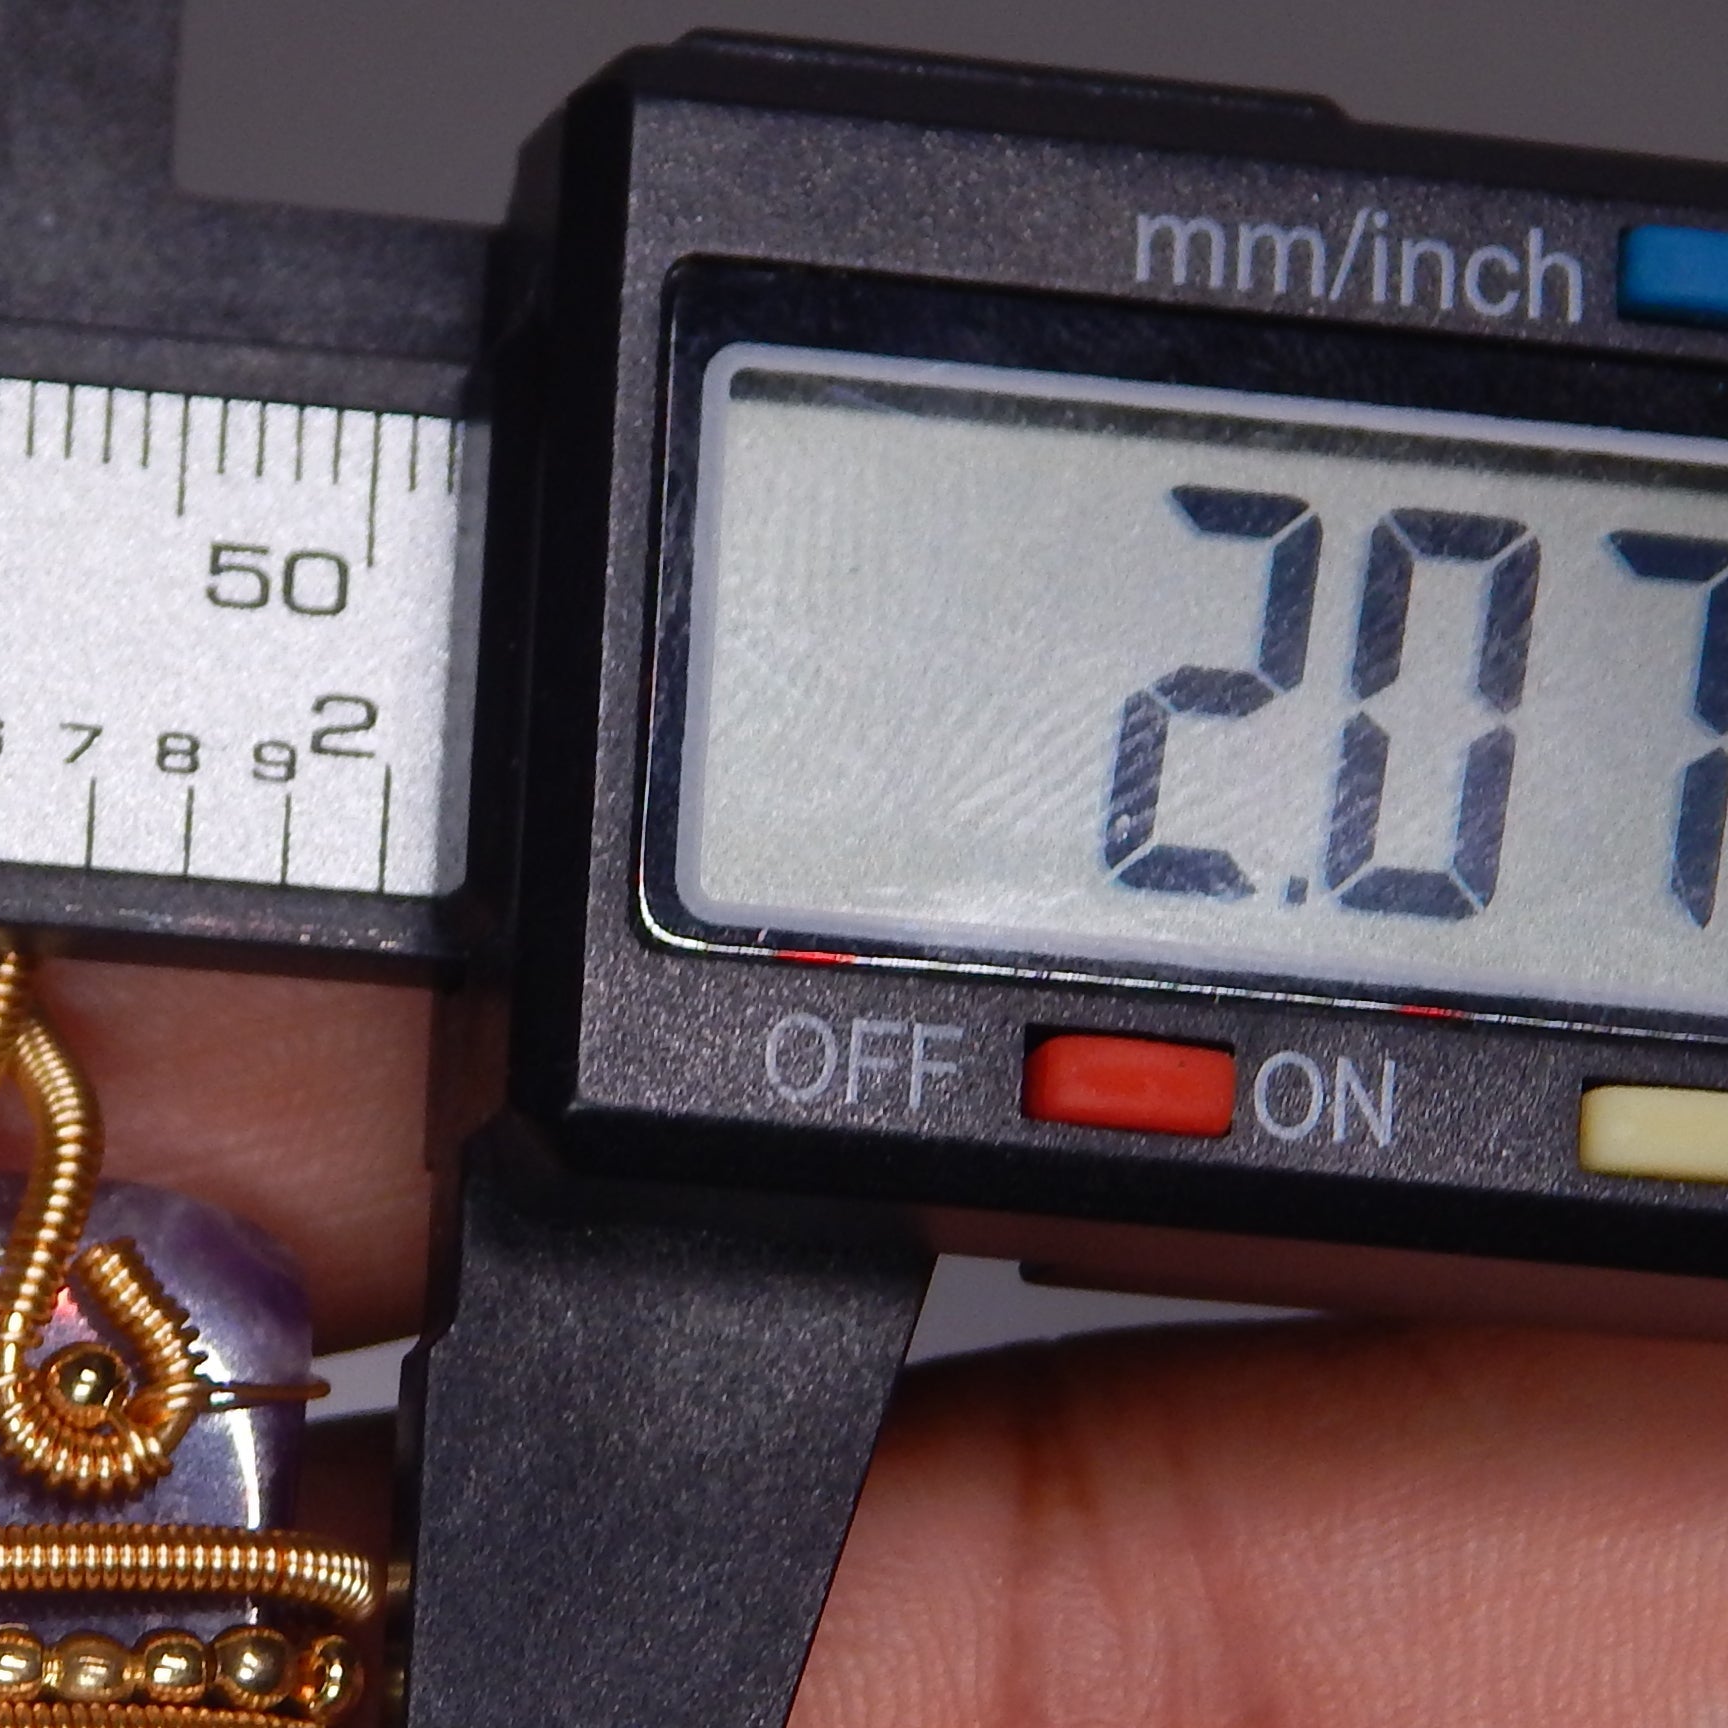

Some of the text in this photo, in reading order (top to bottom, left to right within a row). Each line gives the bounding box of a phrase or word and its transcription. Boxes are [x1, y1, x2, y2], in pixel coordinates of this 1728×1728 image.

[1133, 206, 1584, 325] mm/inch
[206, 543, 349, 617] 50
[60, 723, 103, 764] 7
[156, 732, 201, 775] 8
[252, 740, 297, 783] 9
[310, 694, 378, 758] 2
[764, 1012, 1399, 1147] OFF ON
